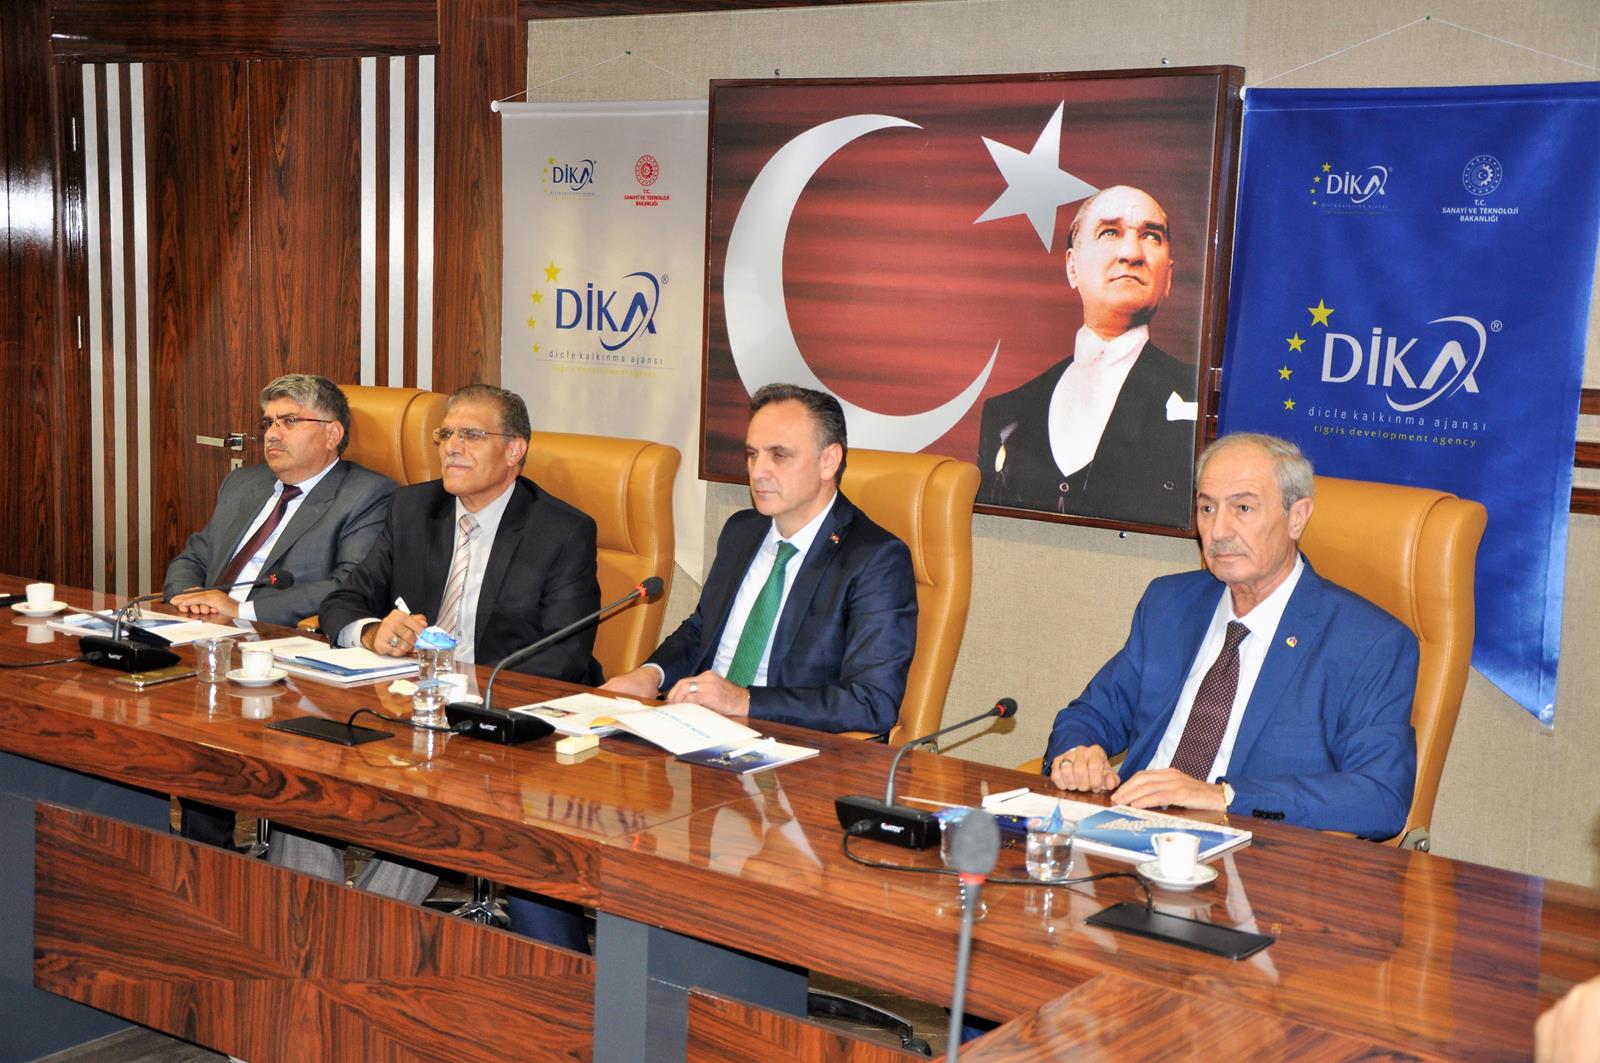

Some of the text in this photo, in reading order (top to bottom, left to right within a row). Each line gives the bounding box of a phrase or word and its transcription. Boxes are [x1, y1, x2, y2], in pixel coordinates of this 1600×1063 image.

[553, 159, 593, 191] DİKA
[1326, 165, 1388, 204] DİKA
[1442, 206, 1467, 214] SANAYİ
[1479, 206, 1519, 215] TEKNOLOJİ
[555, 271, 660, 351] DİKA
[1321, 315, 1487, 412] DİKA
[1308, 406, 1486, 431] dicle kalkınma ajansı
[1314, 424, 1477, 448] tigris development agency
